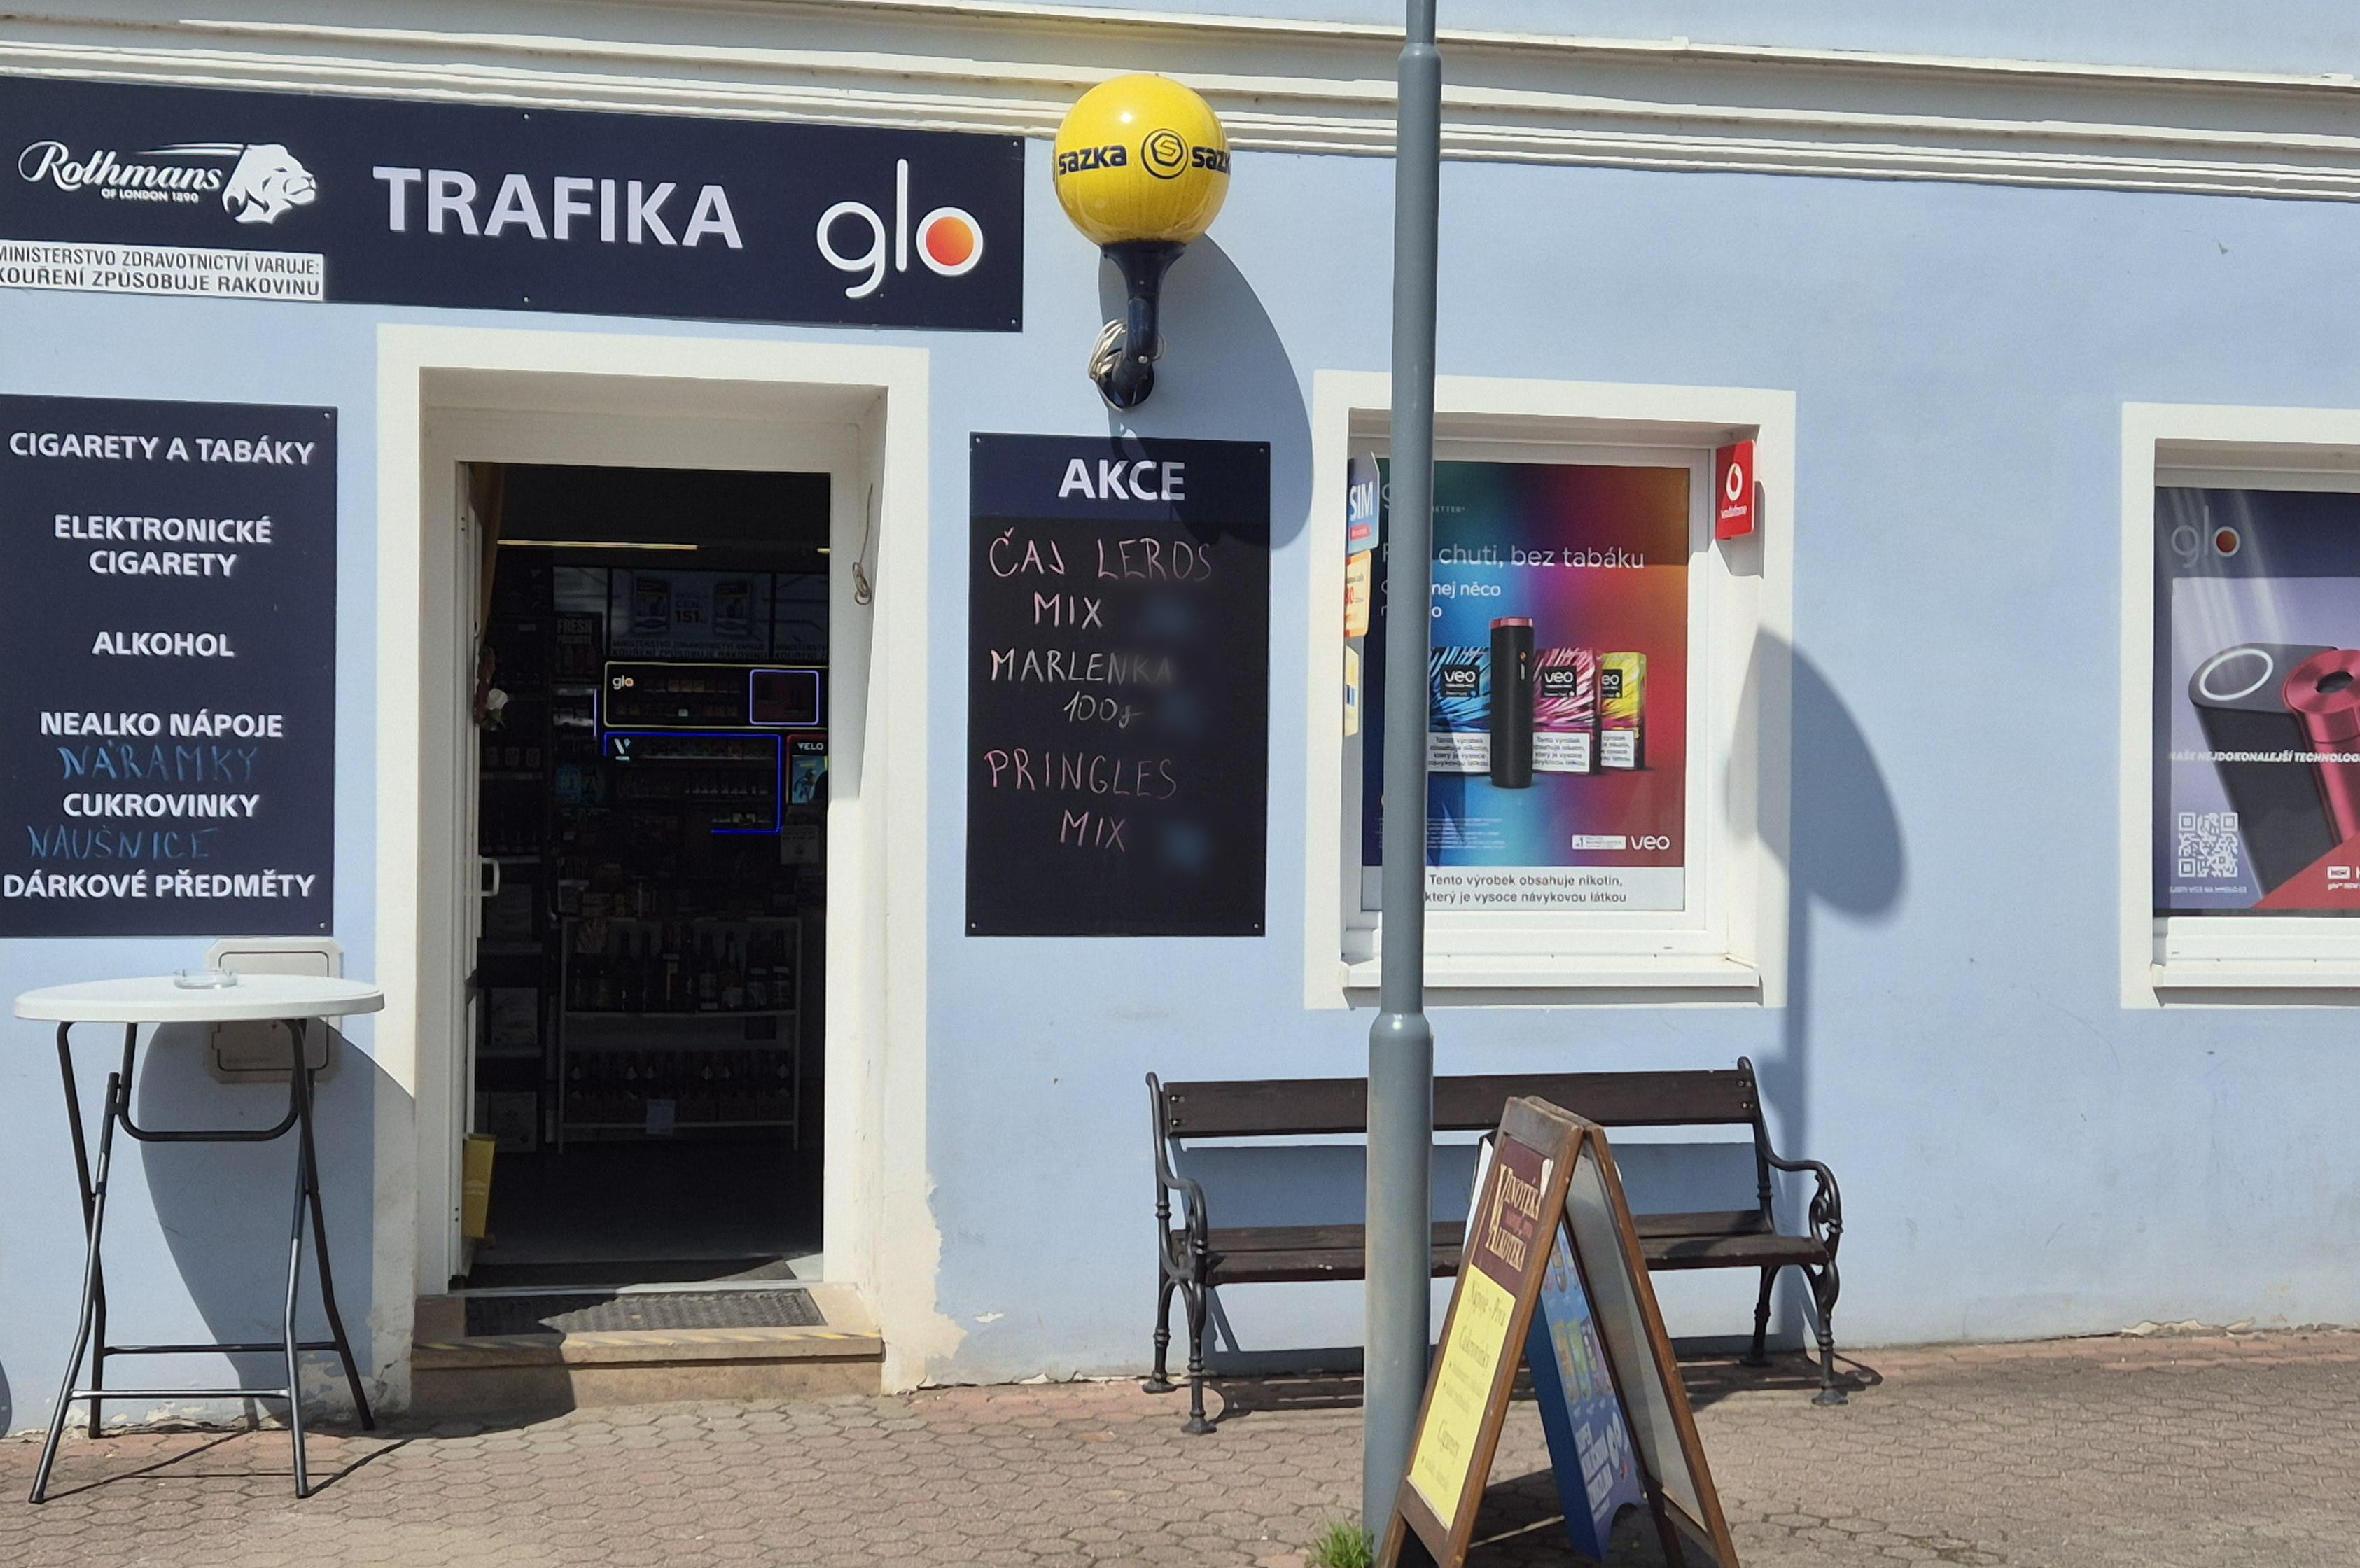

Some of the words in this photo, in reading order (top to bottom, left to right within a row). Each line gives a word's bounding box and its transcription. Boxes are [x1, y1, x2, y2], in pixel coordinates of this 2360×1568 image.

[18, 141, 223, 191] Rothmans
[102, 188, 116, 200] OF
[120, 190, 168, 202] LONDON
[172, 192, 199, 203] 1890
[372, 165, 743, 250] TRAFIKA
[816, 158, 983, 298] glo
[122, 251, 250, 272] ZDRAVOTNICTVÍ
[255, 257, 319, 275] VARUJE:
[92, 269, 209, 291] ZPŮSOBUJE
[218, 276, 320, 295] RAKOVINU
[9, 432, 159, 459] CIGARETY
[166, 438, 190, 461] A
[196, 435, 316, 465] TABÁKY
[1057, 458, 1185, 501] AKCE
[1348, 481, 1374, 522] SIM
[55, 514, 272, 544] ELEKTRONICKÉ
[2171, 504, 2240, 568] glo
[89, 550, 237, 577] CIGARETY
[989, 526, 1066, 578] ČAJ
[1096, 536, 1213, 582] LEROS
[1439, 543, 1504, 568] chuti,
[1511, 544, 1556, 566] bez
[1562, 546, 1645, 569] tabáku
[1460, 580, 1501, 596] něco
[1033, 591, 1103, 629] MIX
[92, 631, 235, 658] ALKOHOL
[990, 648, 1173, 684] MARLENKA
[1444, 670, 1476, 683] veo
[1544, 669, 1574, 683] veo
[1601, 673, 1620, 684] eo
[40, 711, 160, 736] NEALKO
[169, 708, 284, 738] NÁPOJE
[797, 742, 824, 751] VELO
[2294, 752, 2360, 763] TECHNOLOG
[984, 748, 1178, 799] PRINGLES
[63, 793, 260, 818] CUKROVINKY
[1059, 809, 1126, 852] MIX
[1631, 835, 1670, 850] veo
[3, 869, 148, 898] DÁRKOVÉ
[155, 869, 316, 899] PŘEDMĚTY
[1430, 874, 1462, 886] Tento
[1467, 873, 1516, 888] výrobek
[1519, 874, 1575, 888] obsahuje
[1579, 875, 1624, 888] nikotin,
[1425, 891, 1455, 906] který
[1460, 892, 1470, 905] je
[1475, 894, 1518, 906] vysoce
[1521, 891, 1586, 906] návykovou
[1590, 891, 1627, 903] látkou
